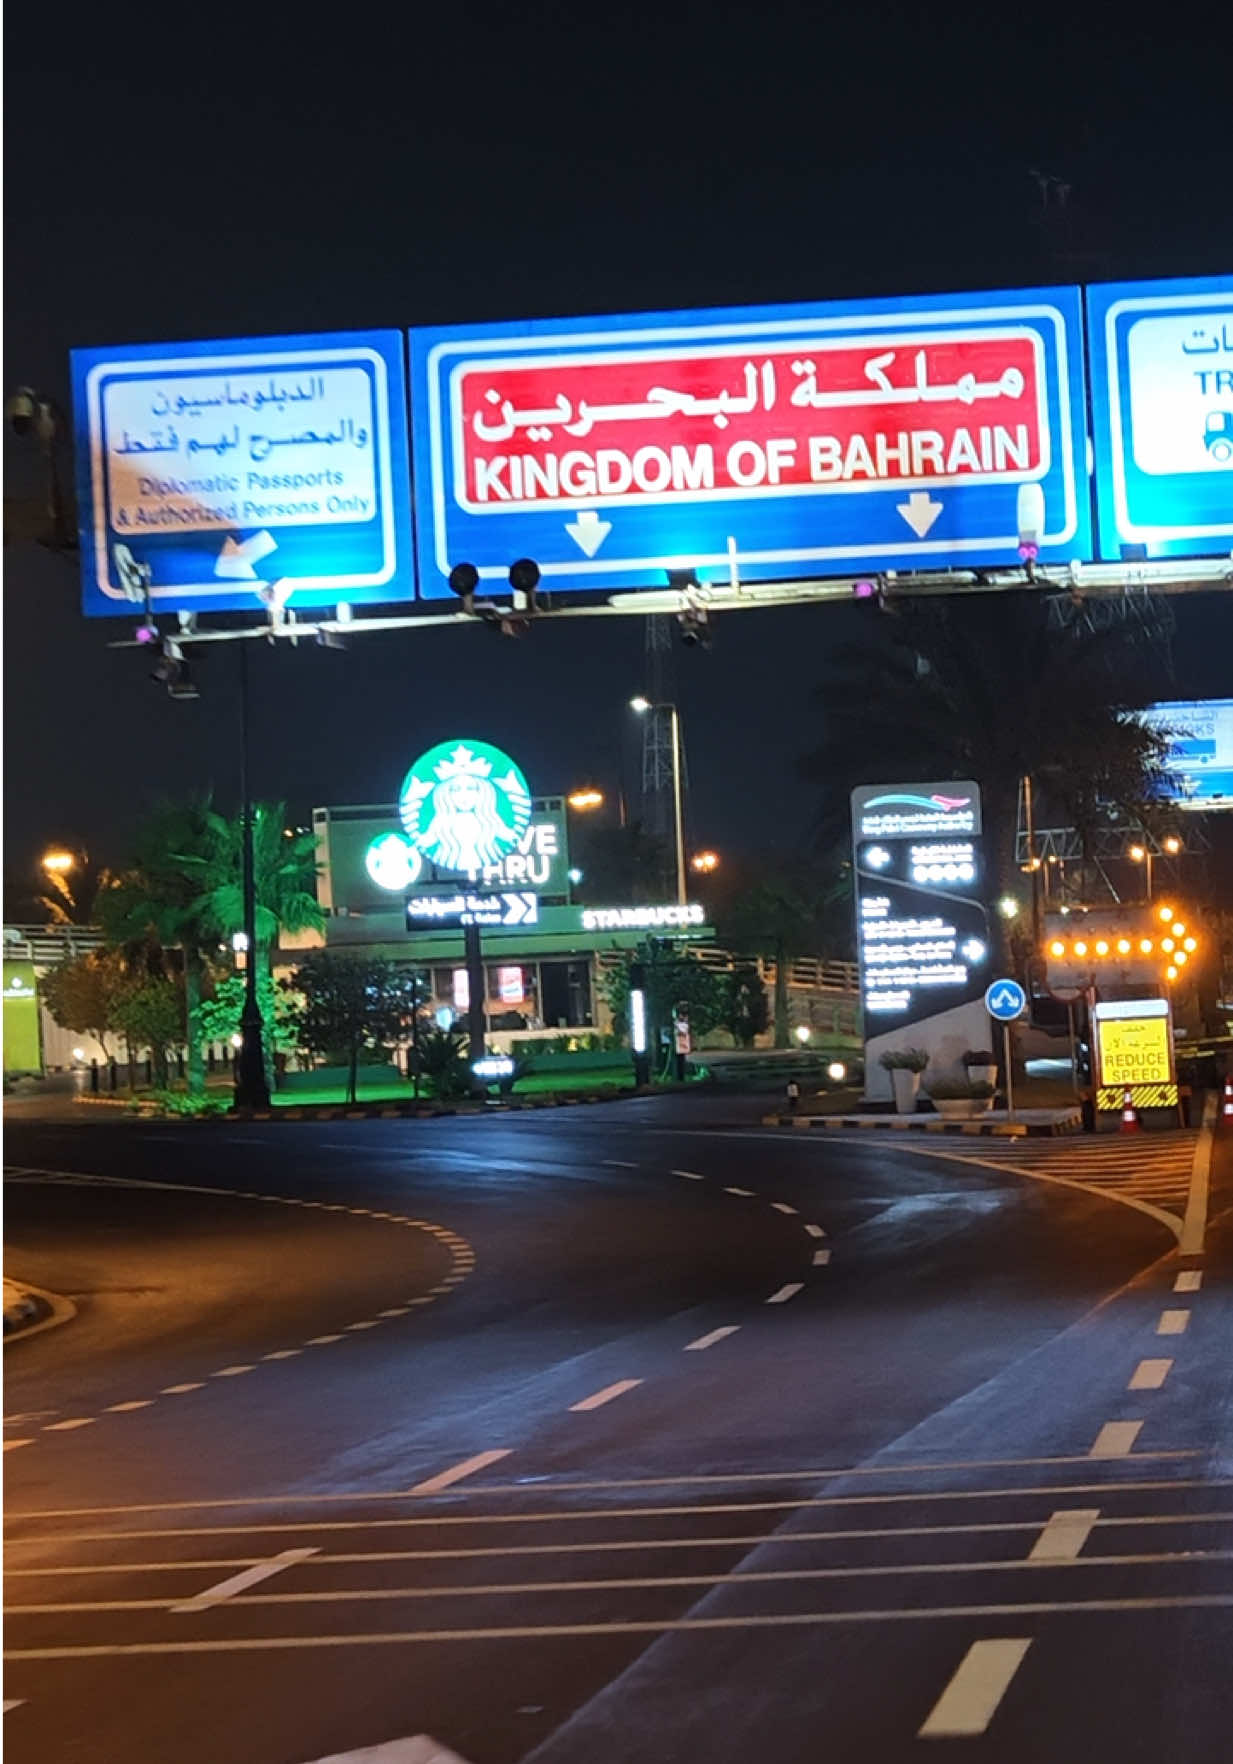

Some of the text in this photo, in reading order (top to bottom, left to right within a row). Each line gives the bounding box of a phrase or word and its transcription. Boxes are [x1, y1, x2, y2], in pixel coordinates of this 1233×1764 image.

[151, 376, 325, 417] الدبلوماسيون
[473, 350, 1024, 442] مملكة البحرين
[113, 419, 369, 462] والمصرح لهم فقط
[474, 424, 1030, 502] KINGDOM OF BAHRAIN
[138, 468, 344, 497] Diplomatic Passports
[117, 494, 370, 526] & Authorized Persons Only
[580, 904, 704, 929] STARBUCKS
[1104, 1052, 1166, 1067] REDUCE
[1112, 1068, 1162, 1082] SPEED
